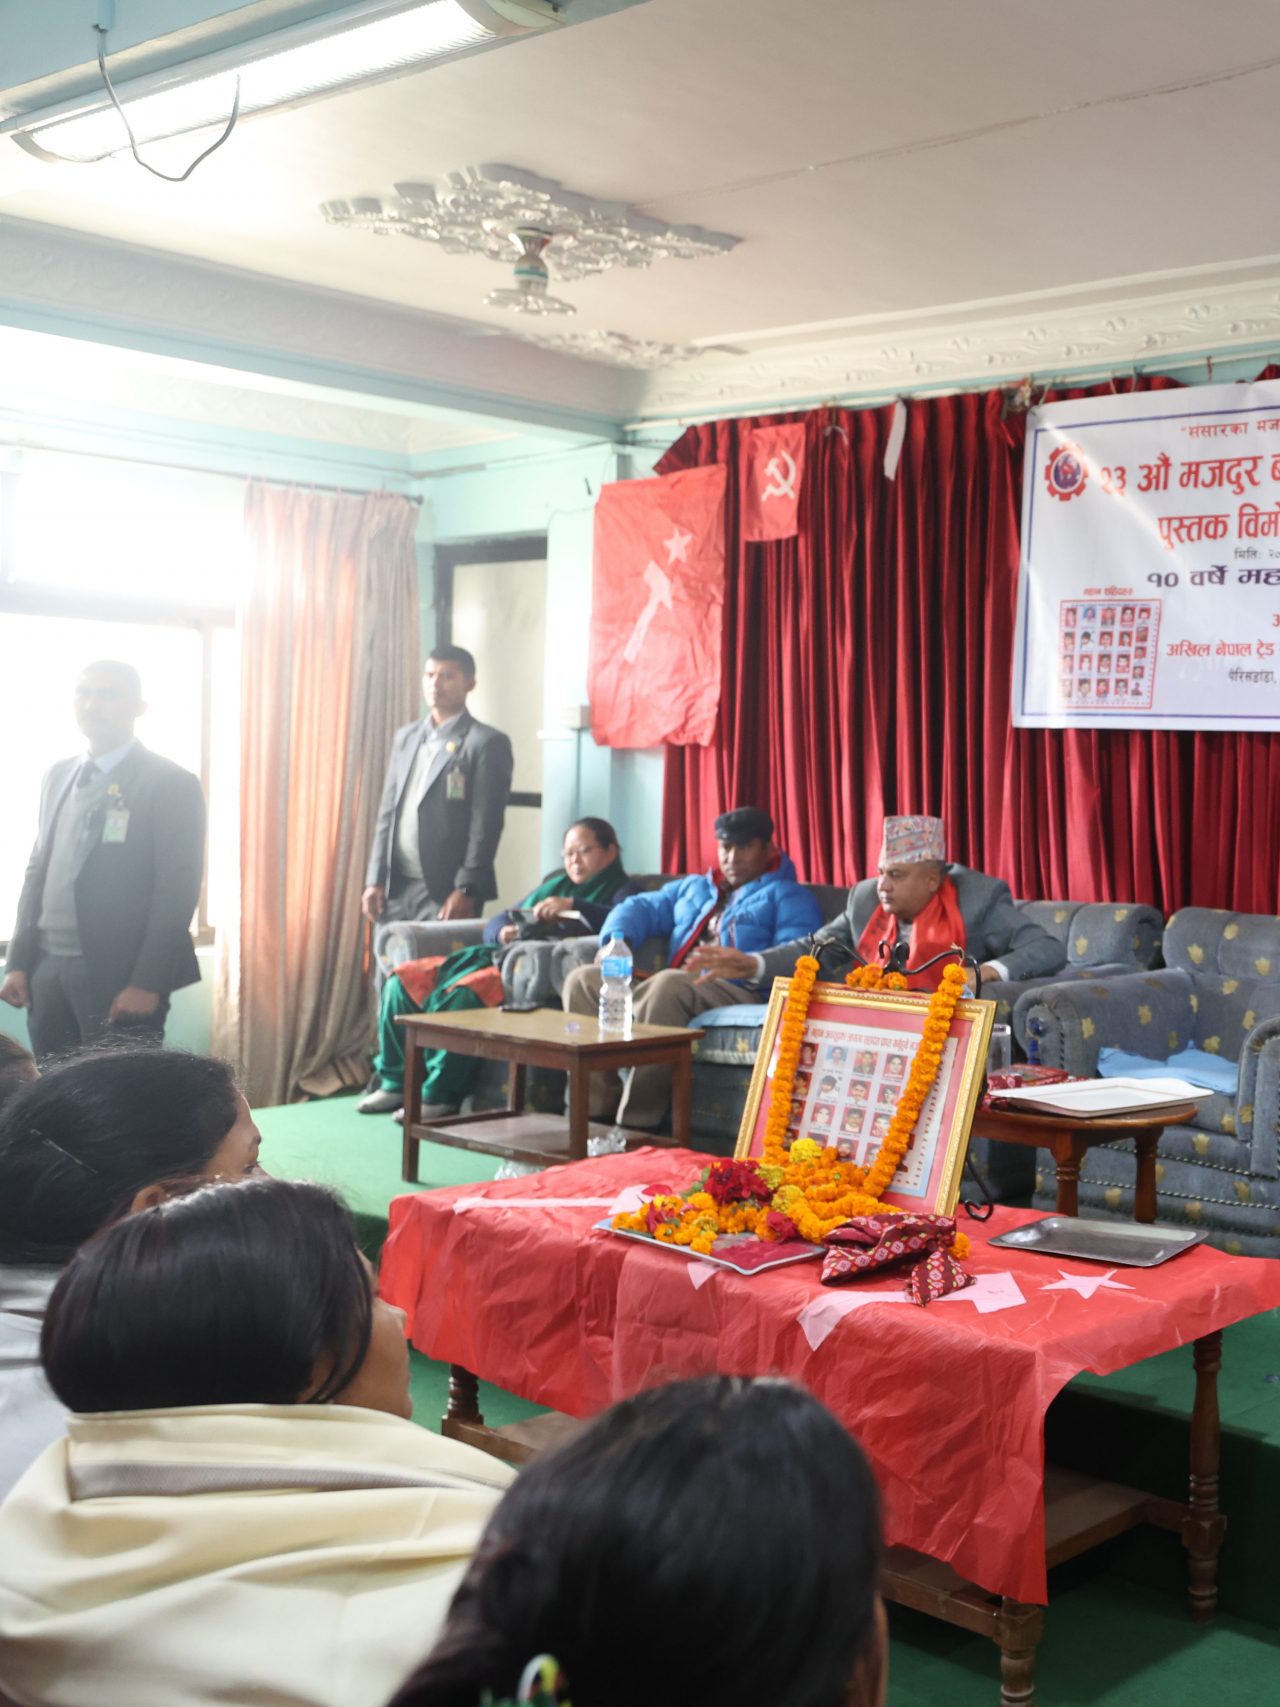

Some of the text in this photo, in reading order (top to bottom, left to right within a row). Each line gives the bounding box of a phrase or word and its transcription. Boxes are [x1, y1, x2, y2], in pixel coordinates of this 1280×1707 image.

[1179, 455, 1263, 495] मजदुर
[1158, 513, 1230, 550] पुस्तक
[1147, 573, 1179, 588] १०
[1166, 638, 1210, 657] अखिल
[1215, 639, 1252, 657] नेपाल
[1256, 639, 1274, 660] ट्रेड
